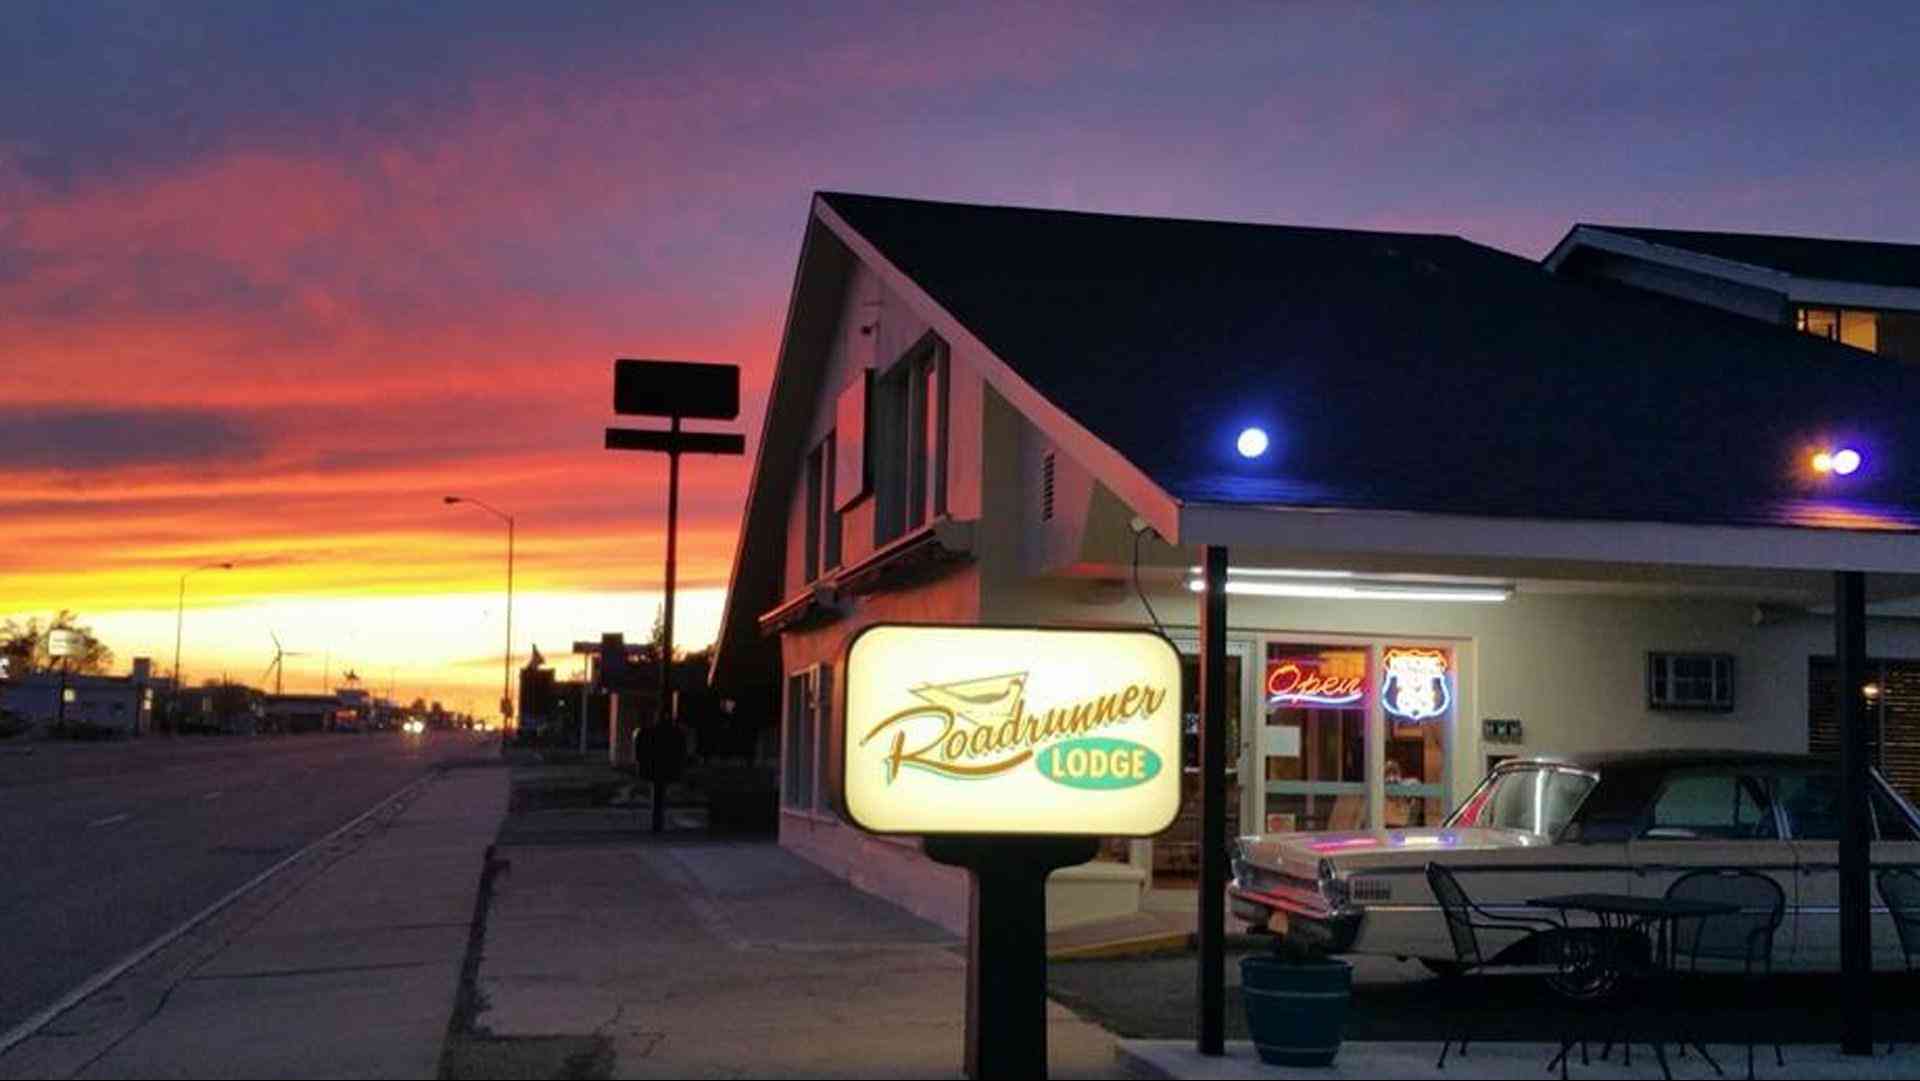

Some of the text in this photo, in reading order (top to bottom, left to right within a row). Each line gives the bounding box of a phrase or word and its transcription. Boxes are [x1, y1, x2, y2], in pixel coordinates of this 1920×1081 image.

[1268, 664, 1362, 702] Open
[860, 684, 1165, 784] Roadrunner
[1051, 747, 1148, 779] LODGE
